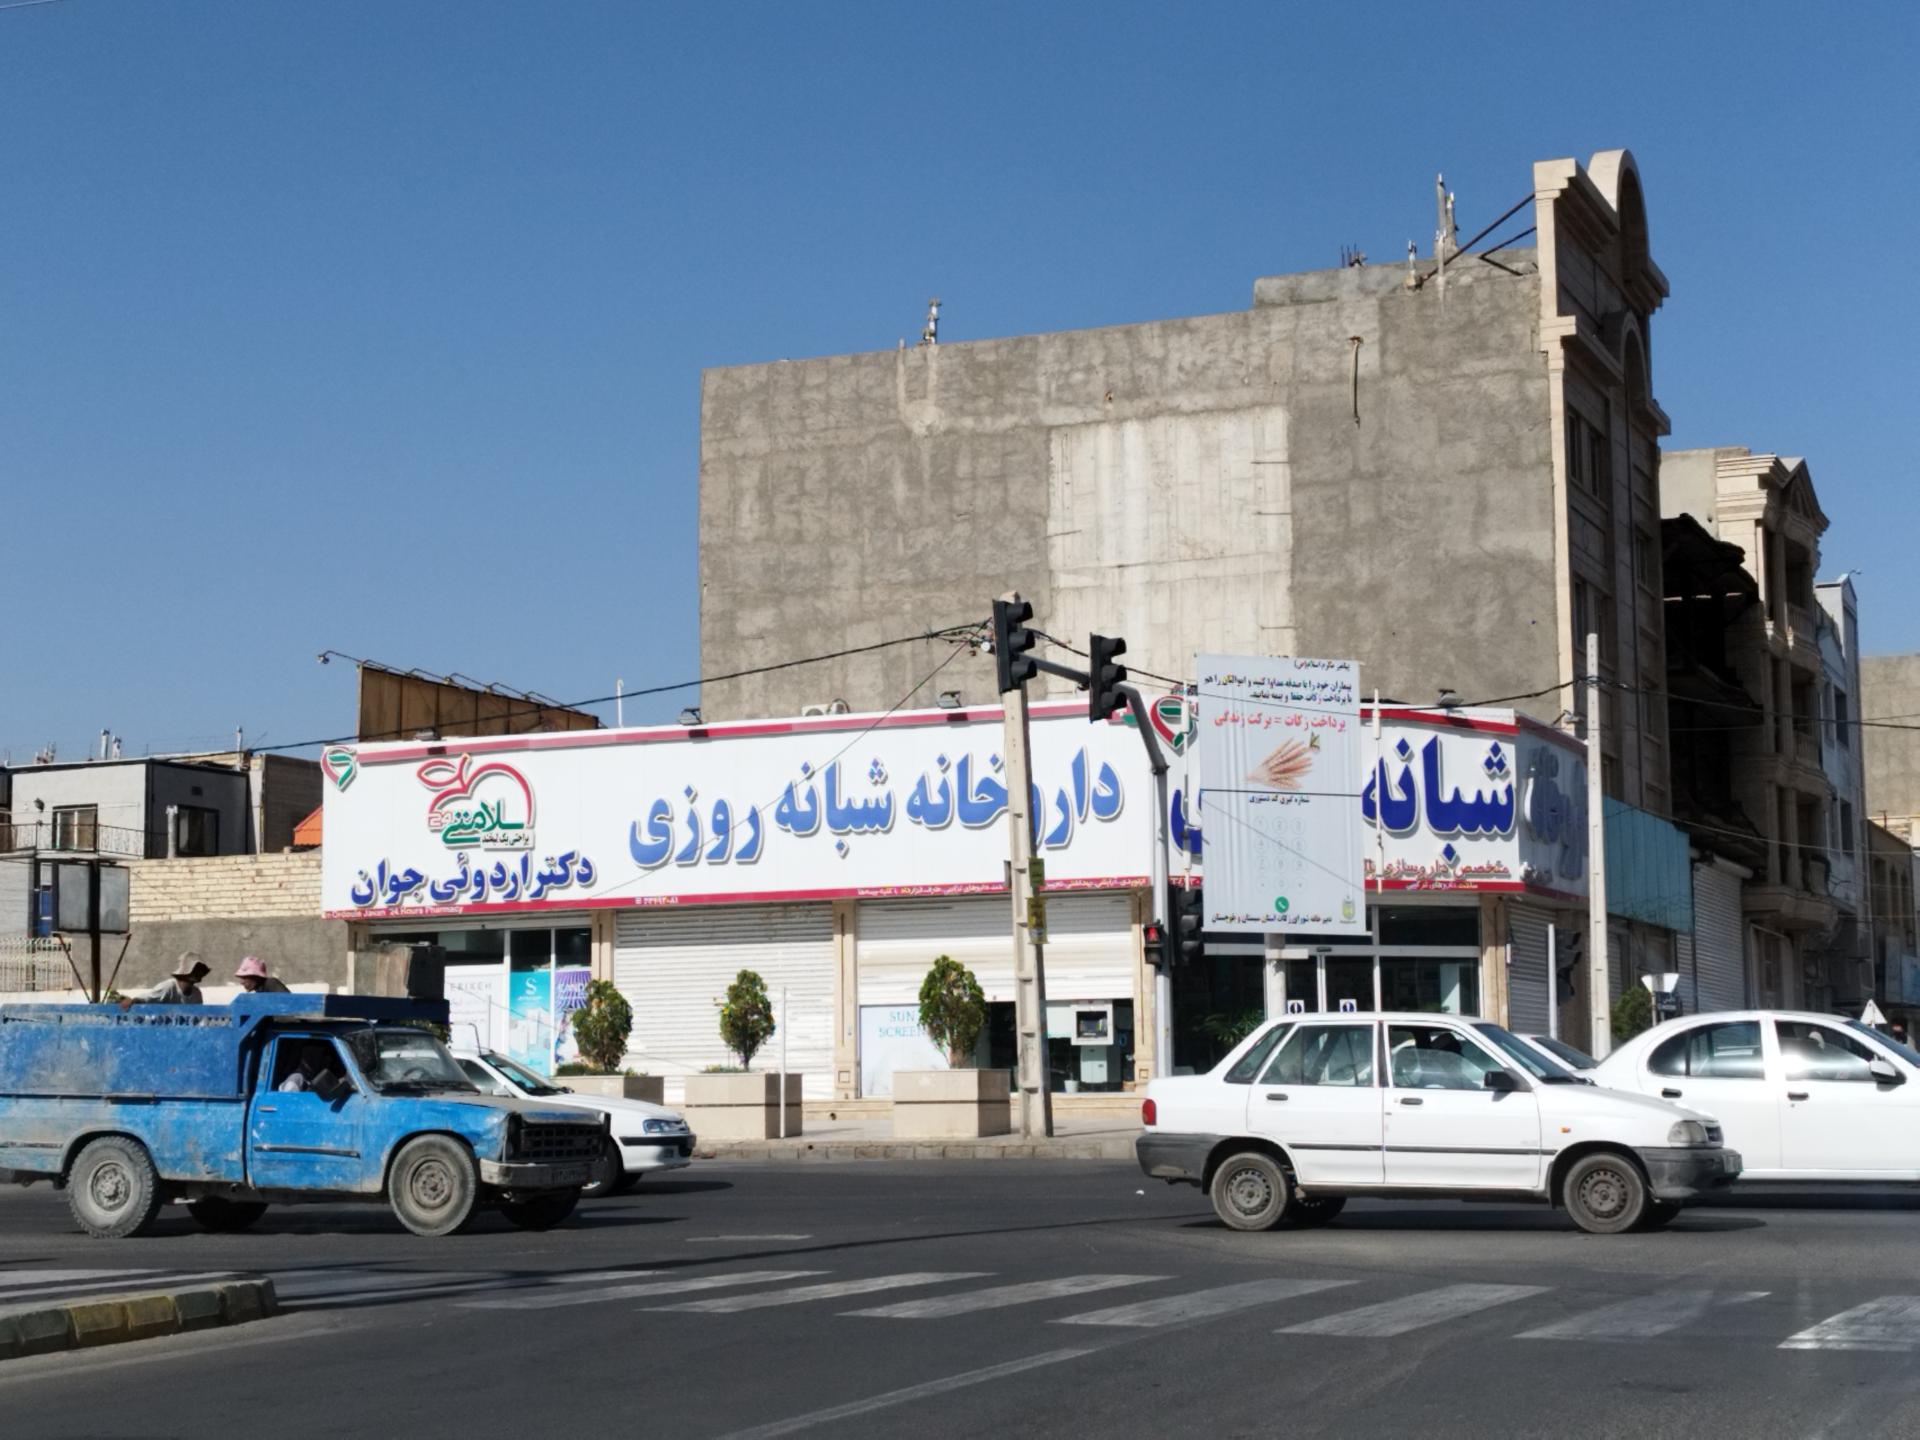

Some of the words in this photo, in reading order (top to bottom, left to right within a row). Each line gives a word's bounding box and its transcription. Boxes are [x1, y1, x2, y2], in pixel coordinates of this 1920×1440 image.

[1214, 710, 1245, 728] زندگی
[1247, 712, 1272, 729] برکت
[1284, 713, 1310, 731] زکات
[1311, 715, 1346, 732] پرداخت
[775, 757, 893, 853] شبانه
[1362, 735, 1515, 863] شبانه
[441, 799, 525, 845] سلامتی
[629, 784, 761, 865] روزی
[529, 850, 593, 899] دکتر
[1453, 859, 1510, 879] متخصص
[351, 856, 425, 905] جوان
[401, 906, 423, 916] Hours
[425, 904, 464, 915] Pharmacy
[889, 1010, 914, 1022] SUN
